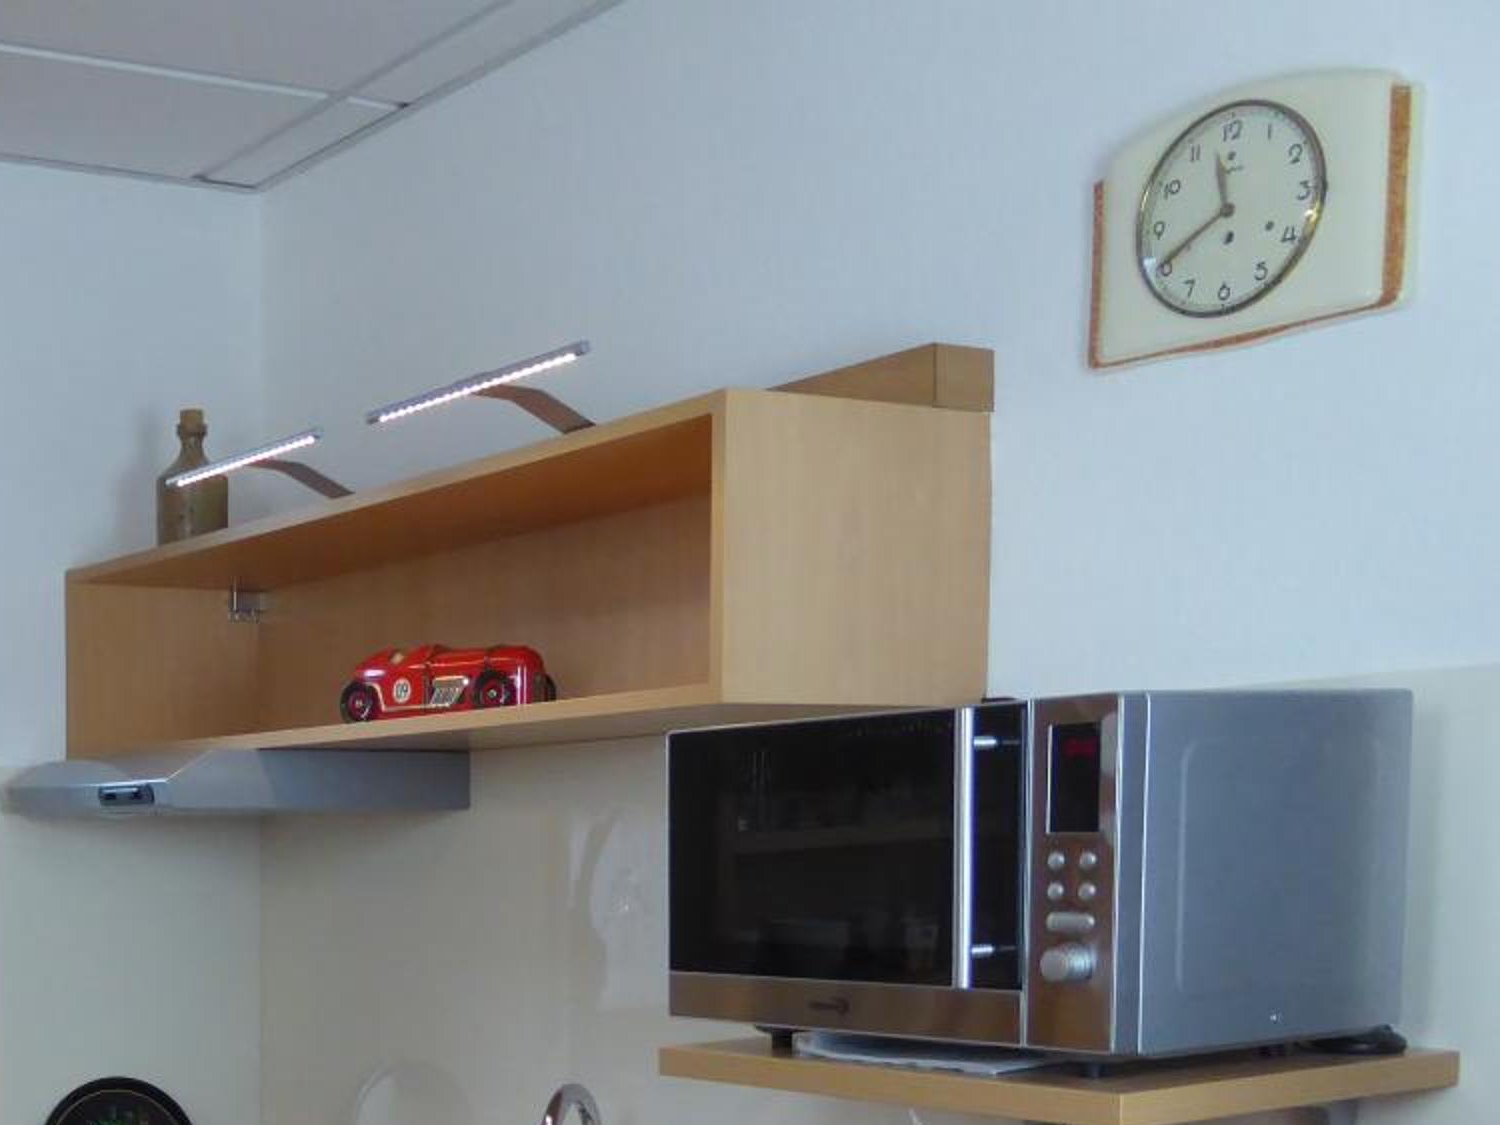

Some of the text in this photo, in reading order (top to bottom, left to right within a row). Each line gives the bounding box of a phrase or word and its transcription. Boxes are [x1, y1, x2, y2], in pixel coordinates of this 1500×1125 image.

[1223, 120, 1242, 141] 12
[1267, 123, 1273, 140] 1
[1190, 144, 1201, 162] 11
[1288, 144, 1303, 164] 2
[1164, 179, 1181, 199] 10
[1297, 180, 1311, 201] 3
[1153, 221, 1166, 240] 9
[1281, 226, 1297, 243] 4
[1254, 261, 1268, 280] 5
[1183, 280, 1195, 297] 7
[1218, 283, 1230, 301] 6
